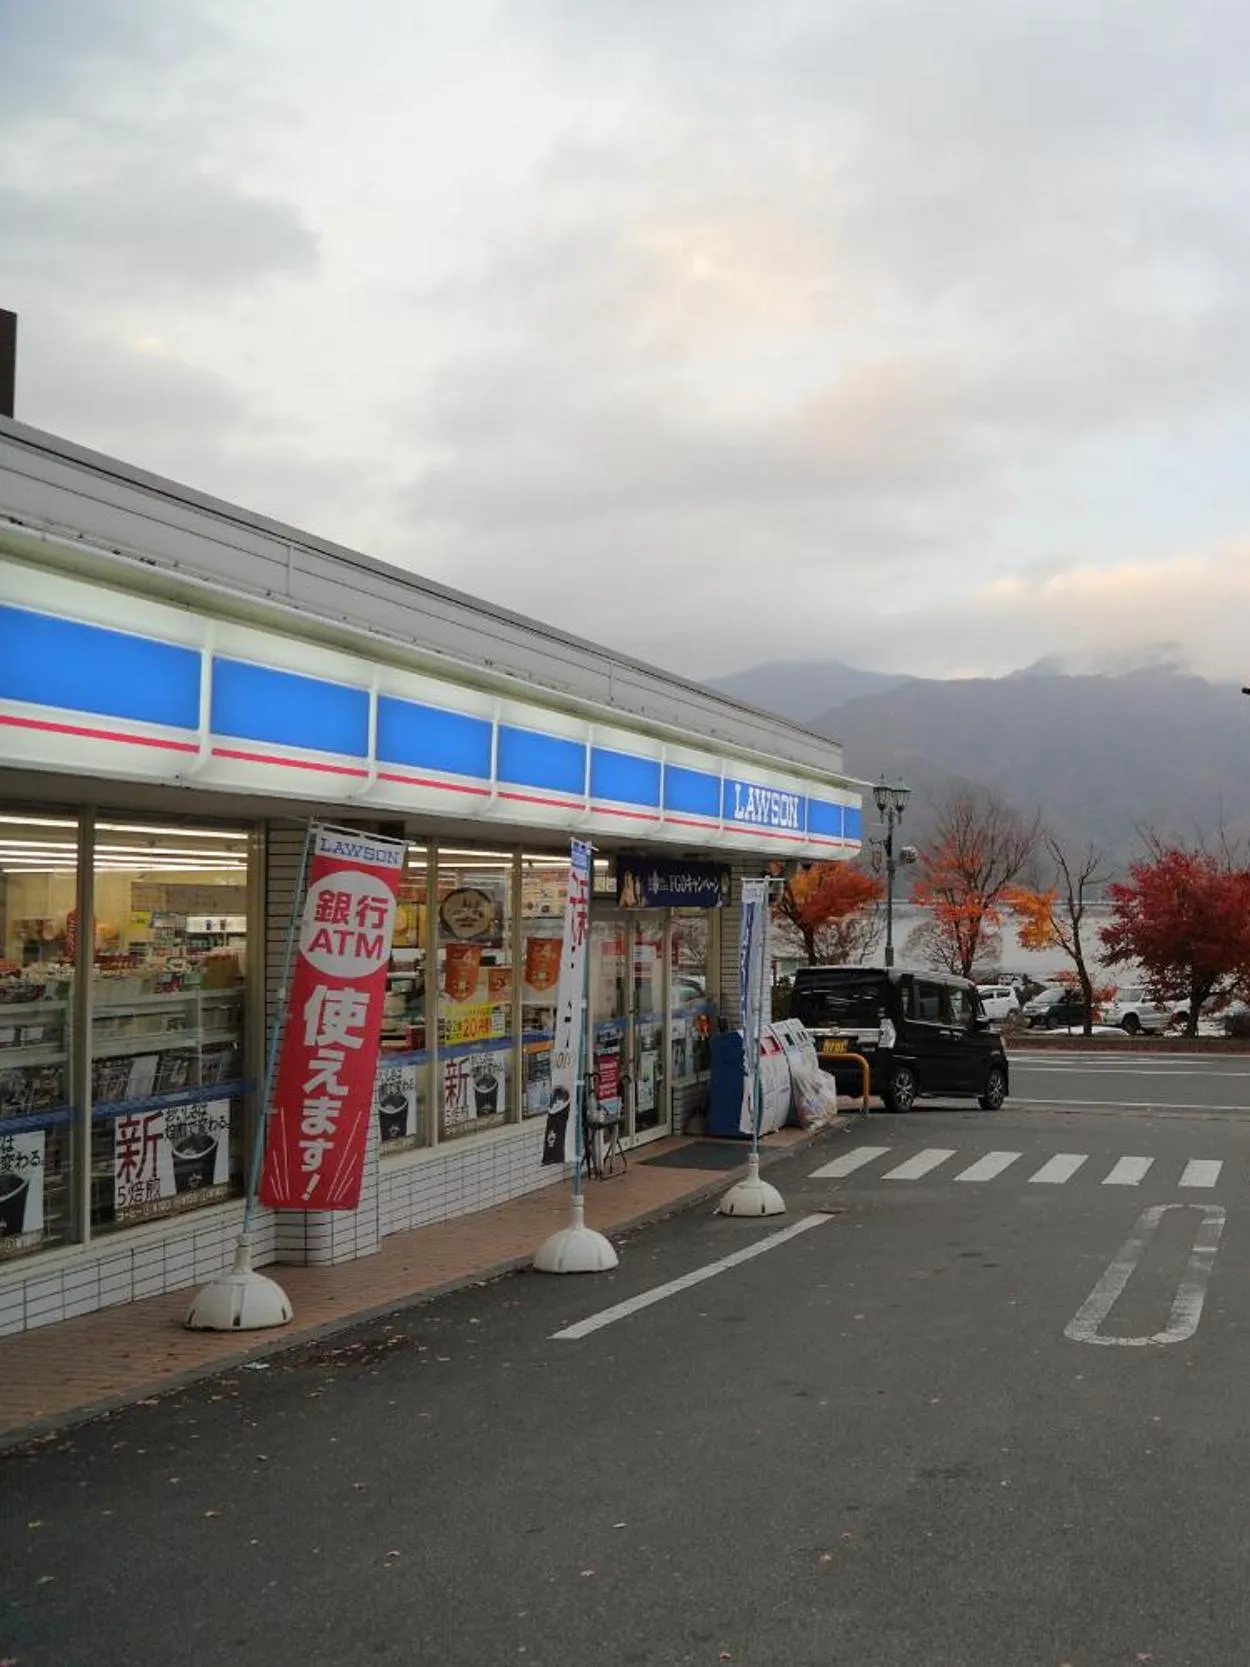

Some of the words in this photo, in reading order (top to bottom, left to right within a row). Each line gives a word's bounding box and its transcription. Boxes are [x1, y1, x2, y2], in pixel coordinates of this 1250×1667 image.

[734, 783, 799, 828] LAWSON
[320, 838, 399, 864] LAWSON
[314, 889, 389, 929] 銀行
[308, 928, 384, 960] ATM
[117, 1111, 164, 1183] 新
